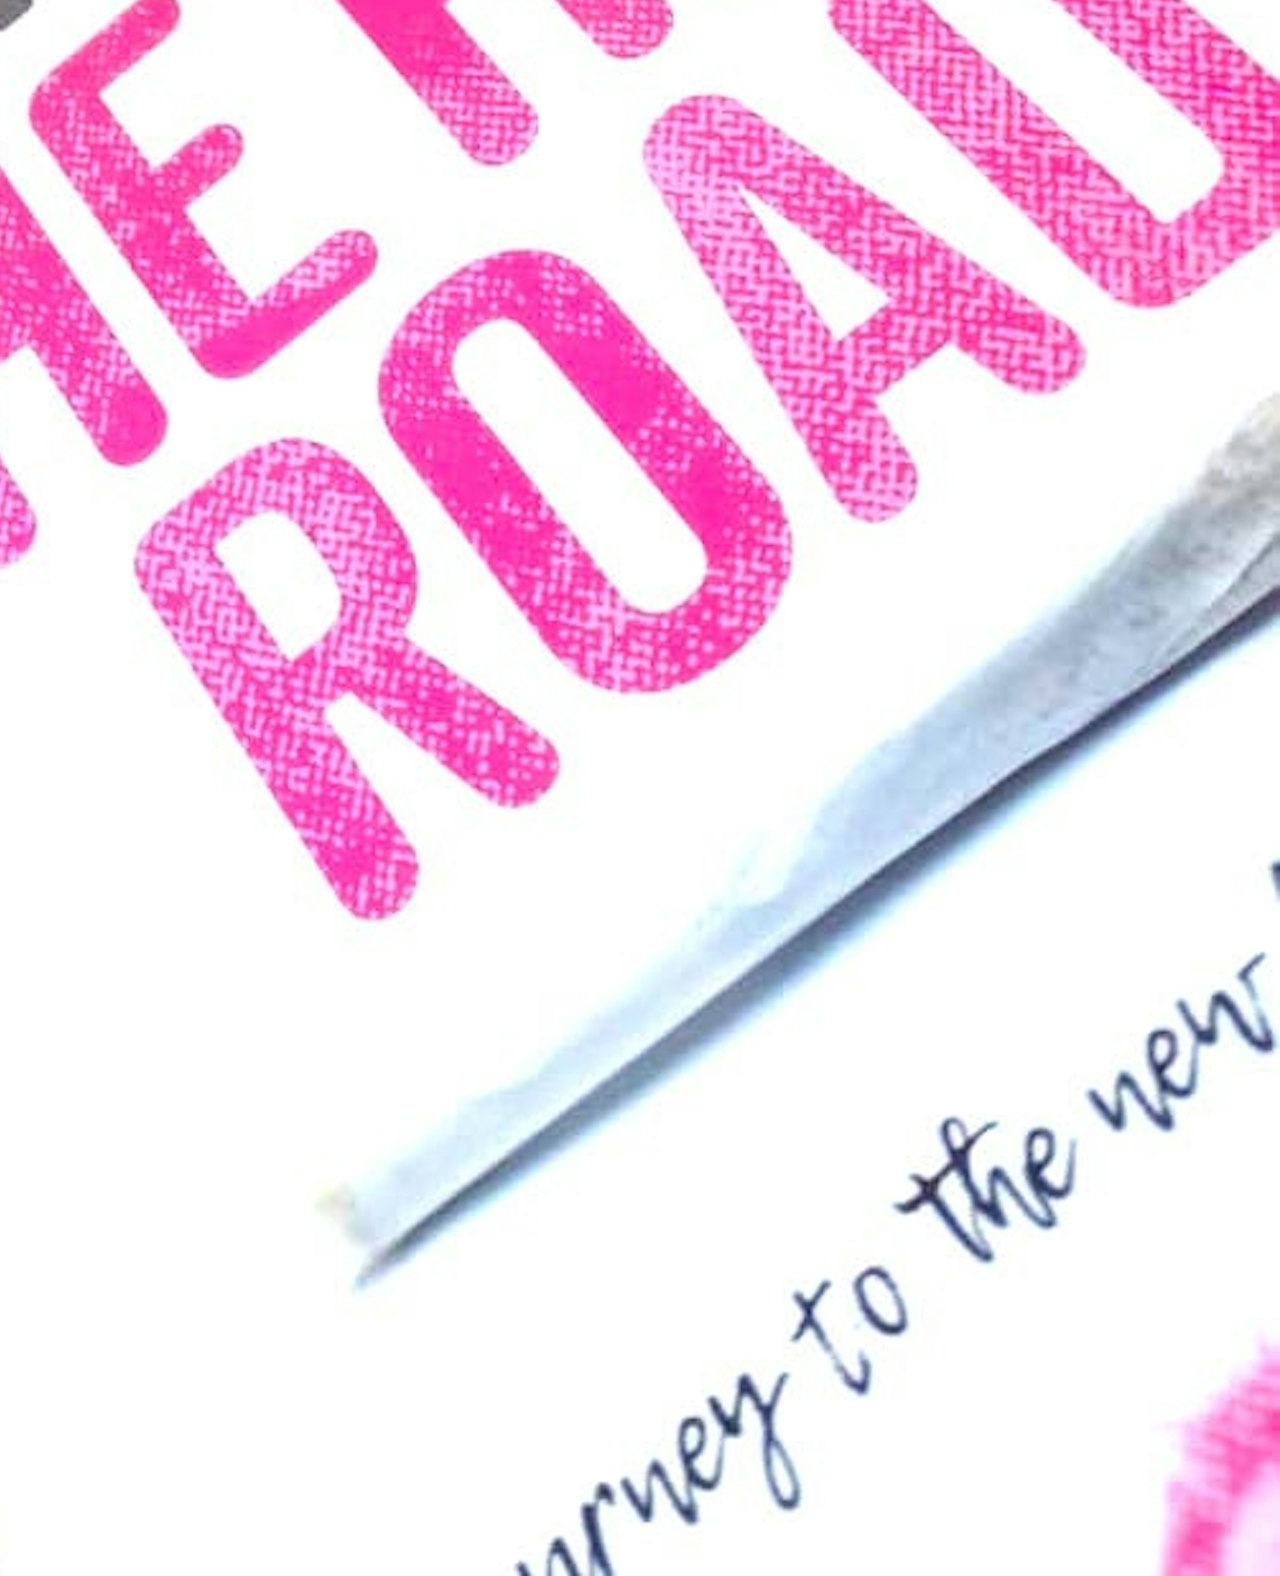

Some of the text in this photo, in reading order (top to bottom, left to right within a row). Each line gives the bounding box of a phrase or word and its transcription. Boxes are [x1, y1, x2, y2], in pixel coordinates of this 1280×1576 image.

[791, 1267, 908, 1395] to
[893, 1116, 1077, 1262] the
[1087, 951, 1276, 1131] new
